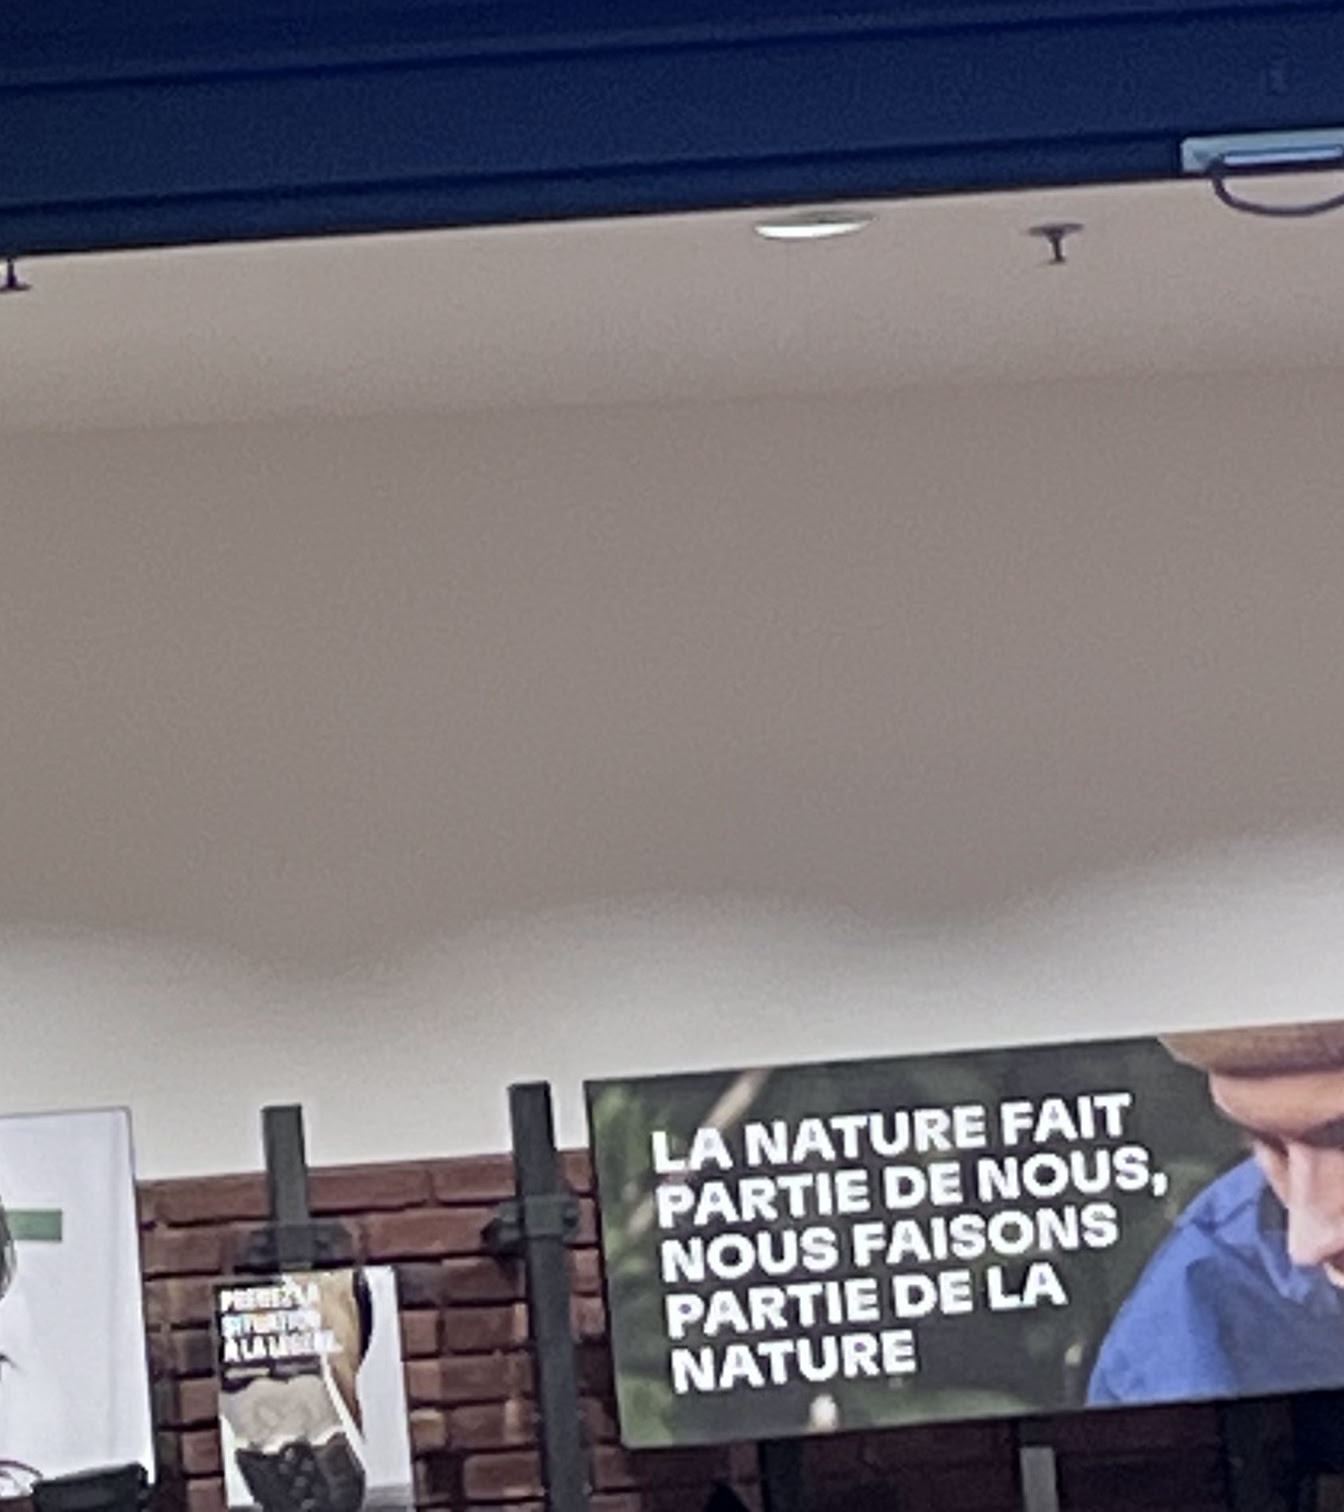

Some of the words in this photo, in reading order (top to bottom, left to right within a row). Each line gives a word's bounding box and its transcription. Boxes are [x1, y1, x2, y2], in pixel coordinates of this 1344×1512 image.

[652, 1127, 733, 1173] LA
[745, 1105, 986, 1167] NATURE
[1001, 1093, 1132, 1145] FAIT
[656, 1169, 870, 1228] PARTIE
[883, 1161, 963, 1209] DE
[977, 1145, 1167, 1202] NOUS,
[661, 1226, 838, 1282] NOUS
[853, 1202, 1118, 1266] FAISONS
[665, 1278, 880, 1339] PARTIE
[892, 1269, 972, 1317] DE
[987, 1262, 1068, 1310] LA
[671, 1329, 916, 1393] NATURE
